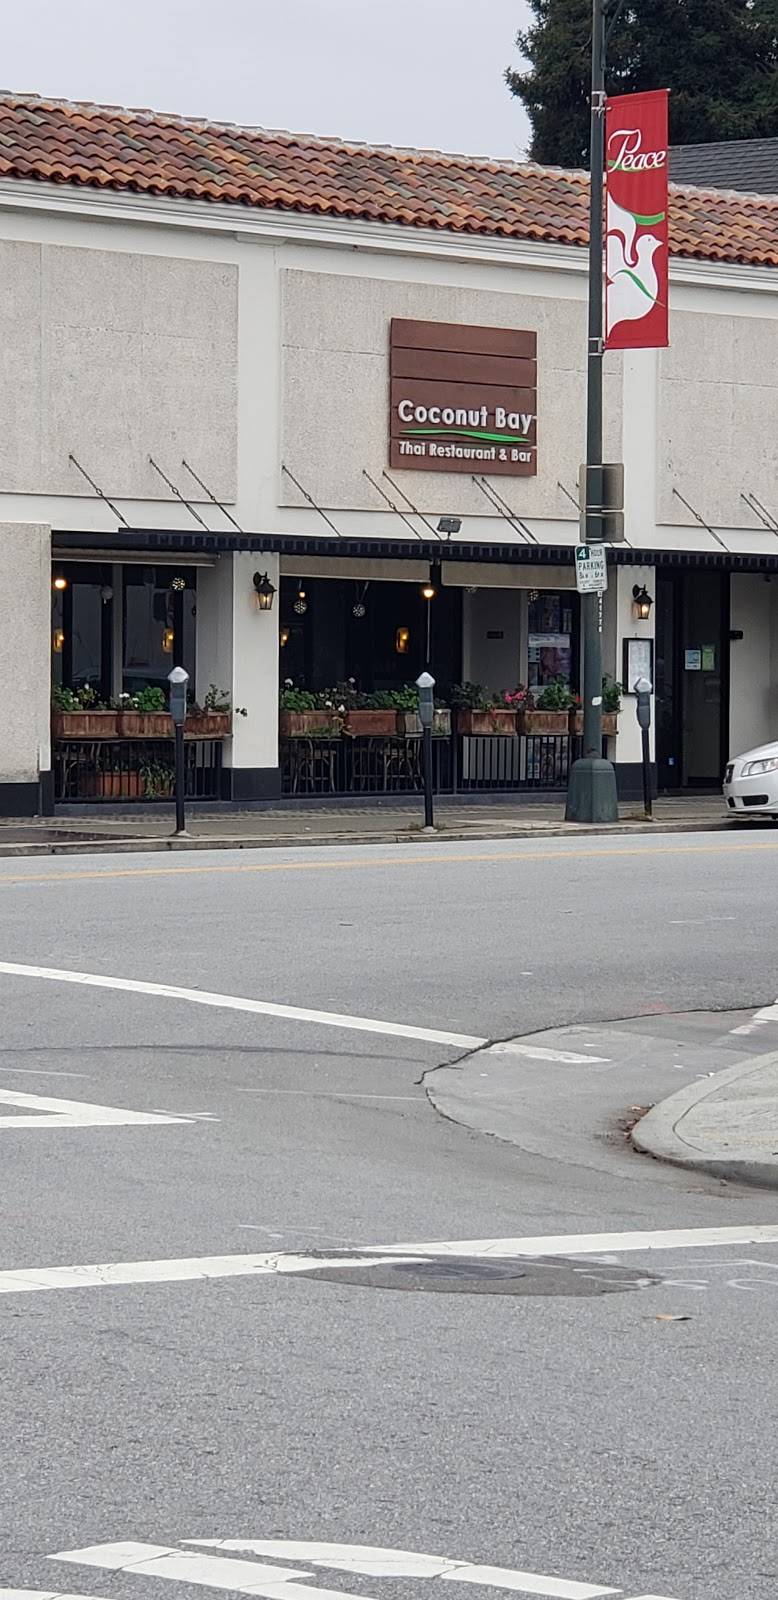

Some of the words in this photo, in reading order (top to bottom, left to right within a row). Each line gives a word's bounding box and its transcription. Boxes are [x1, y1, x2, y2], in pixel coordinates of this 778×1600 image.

[607, 129, 666, 173] Peace
[398, 400, 488, 427] Coconut
[495, 407, 532, 434] Bay
[399, 441, 426, 456] Thai
[429, 443, 496, 460] Restaurant
[499, 448, 507, 460] &
[511, 448, 532, 462] Bar
[578, 548, 587, 559] 4
[578, 560, 604, 571] PARKING
